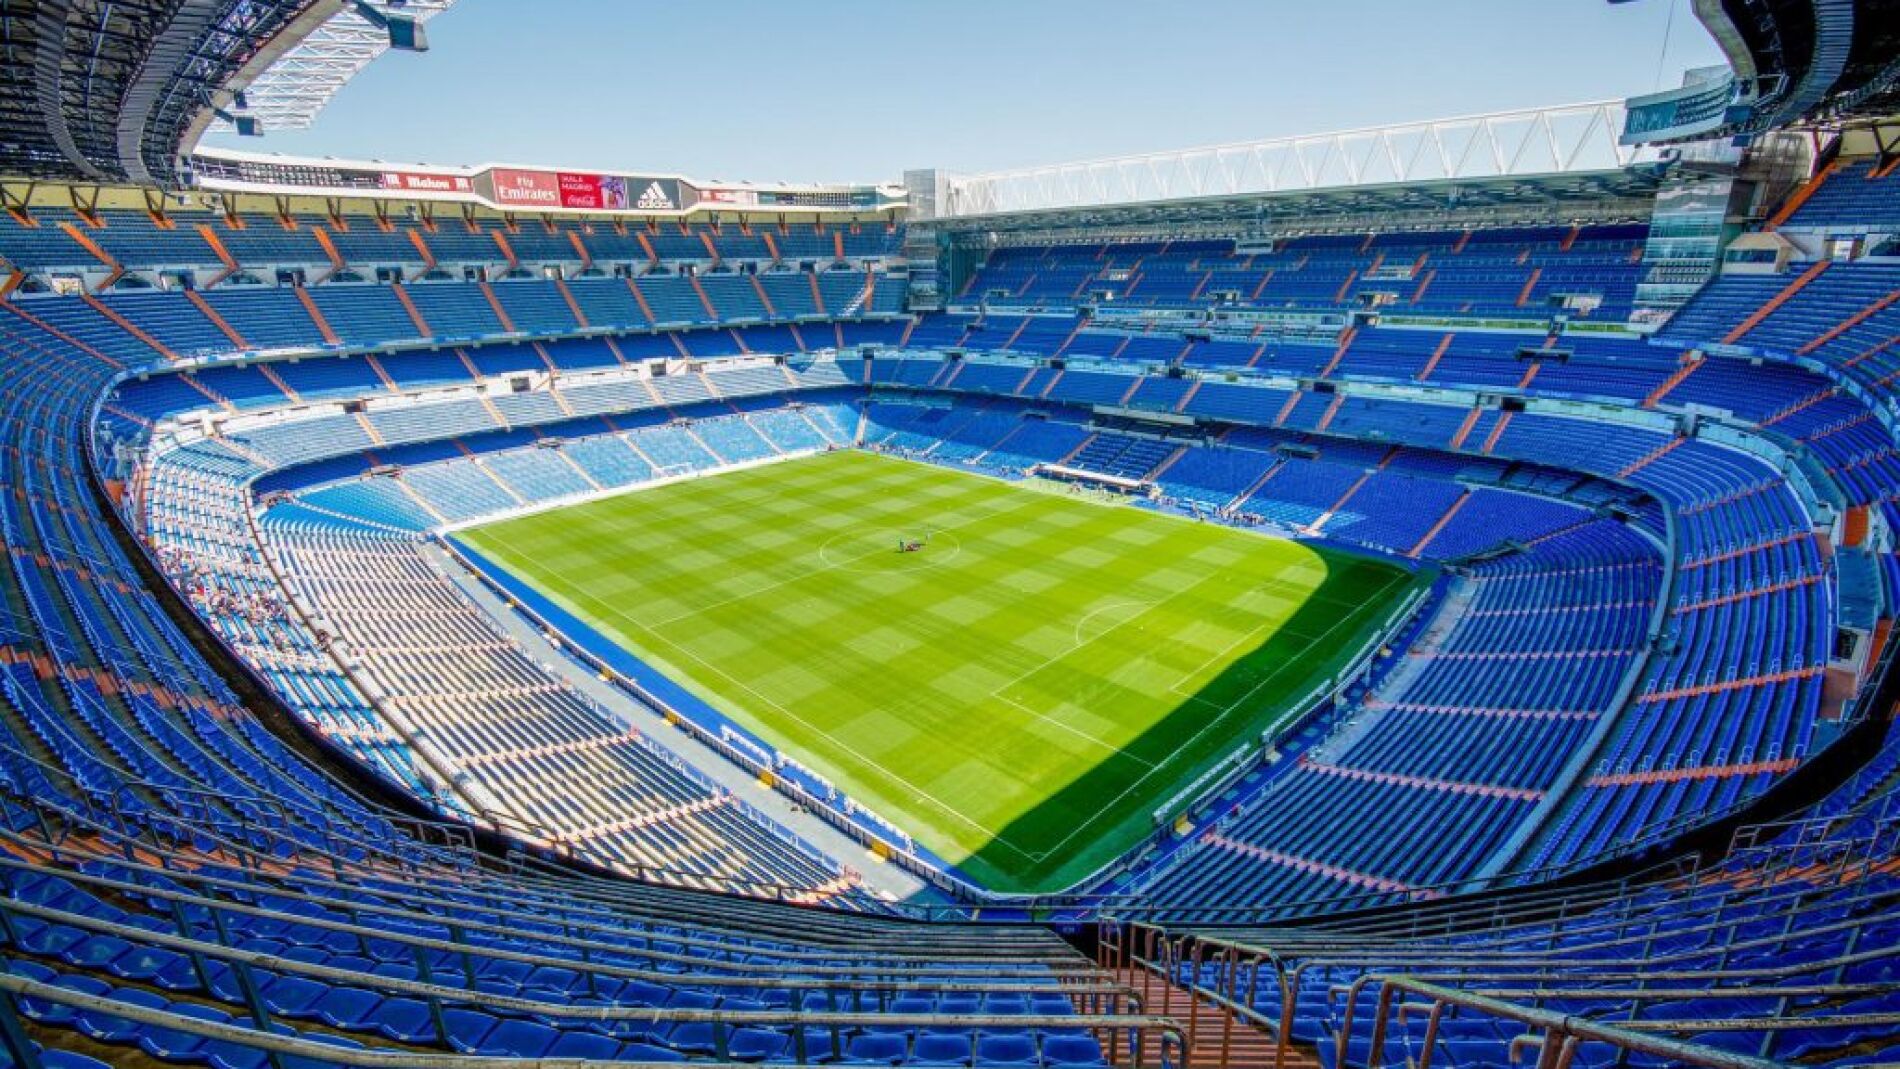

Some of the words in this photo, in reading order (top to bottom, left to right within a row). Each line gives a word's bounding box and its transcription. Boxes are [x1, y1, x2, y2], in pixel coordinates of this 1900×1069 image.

[516, 177, 533, 188] Fly
[498, 186, 555, 201] Emirates
[637, 198, 674, 208] adidas
